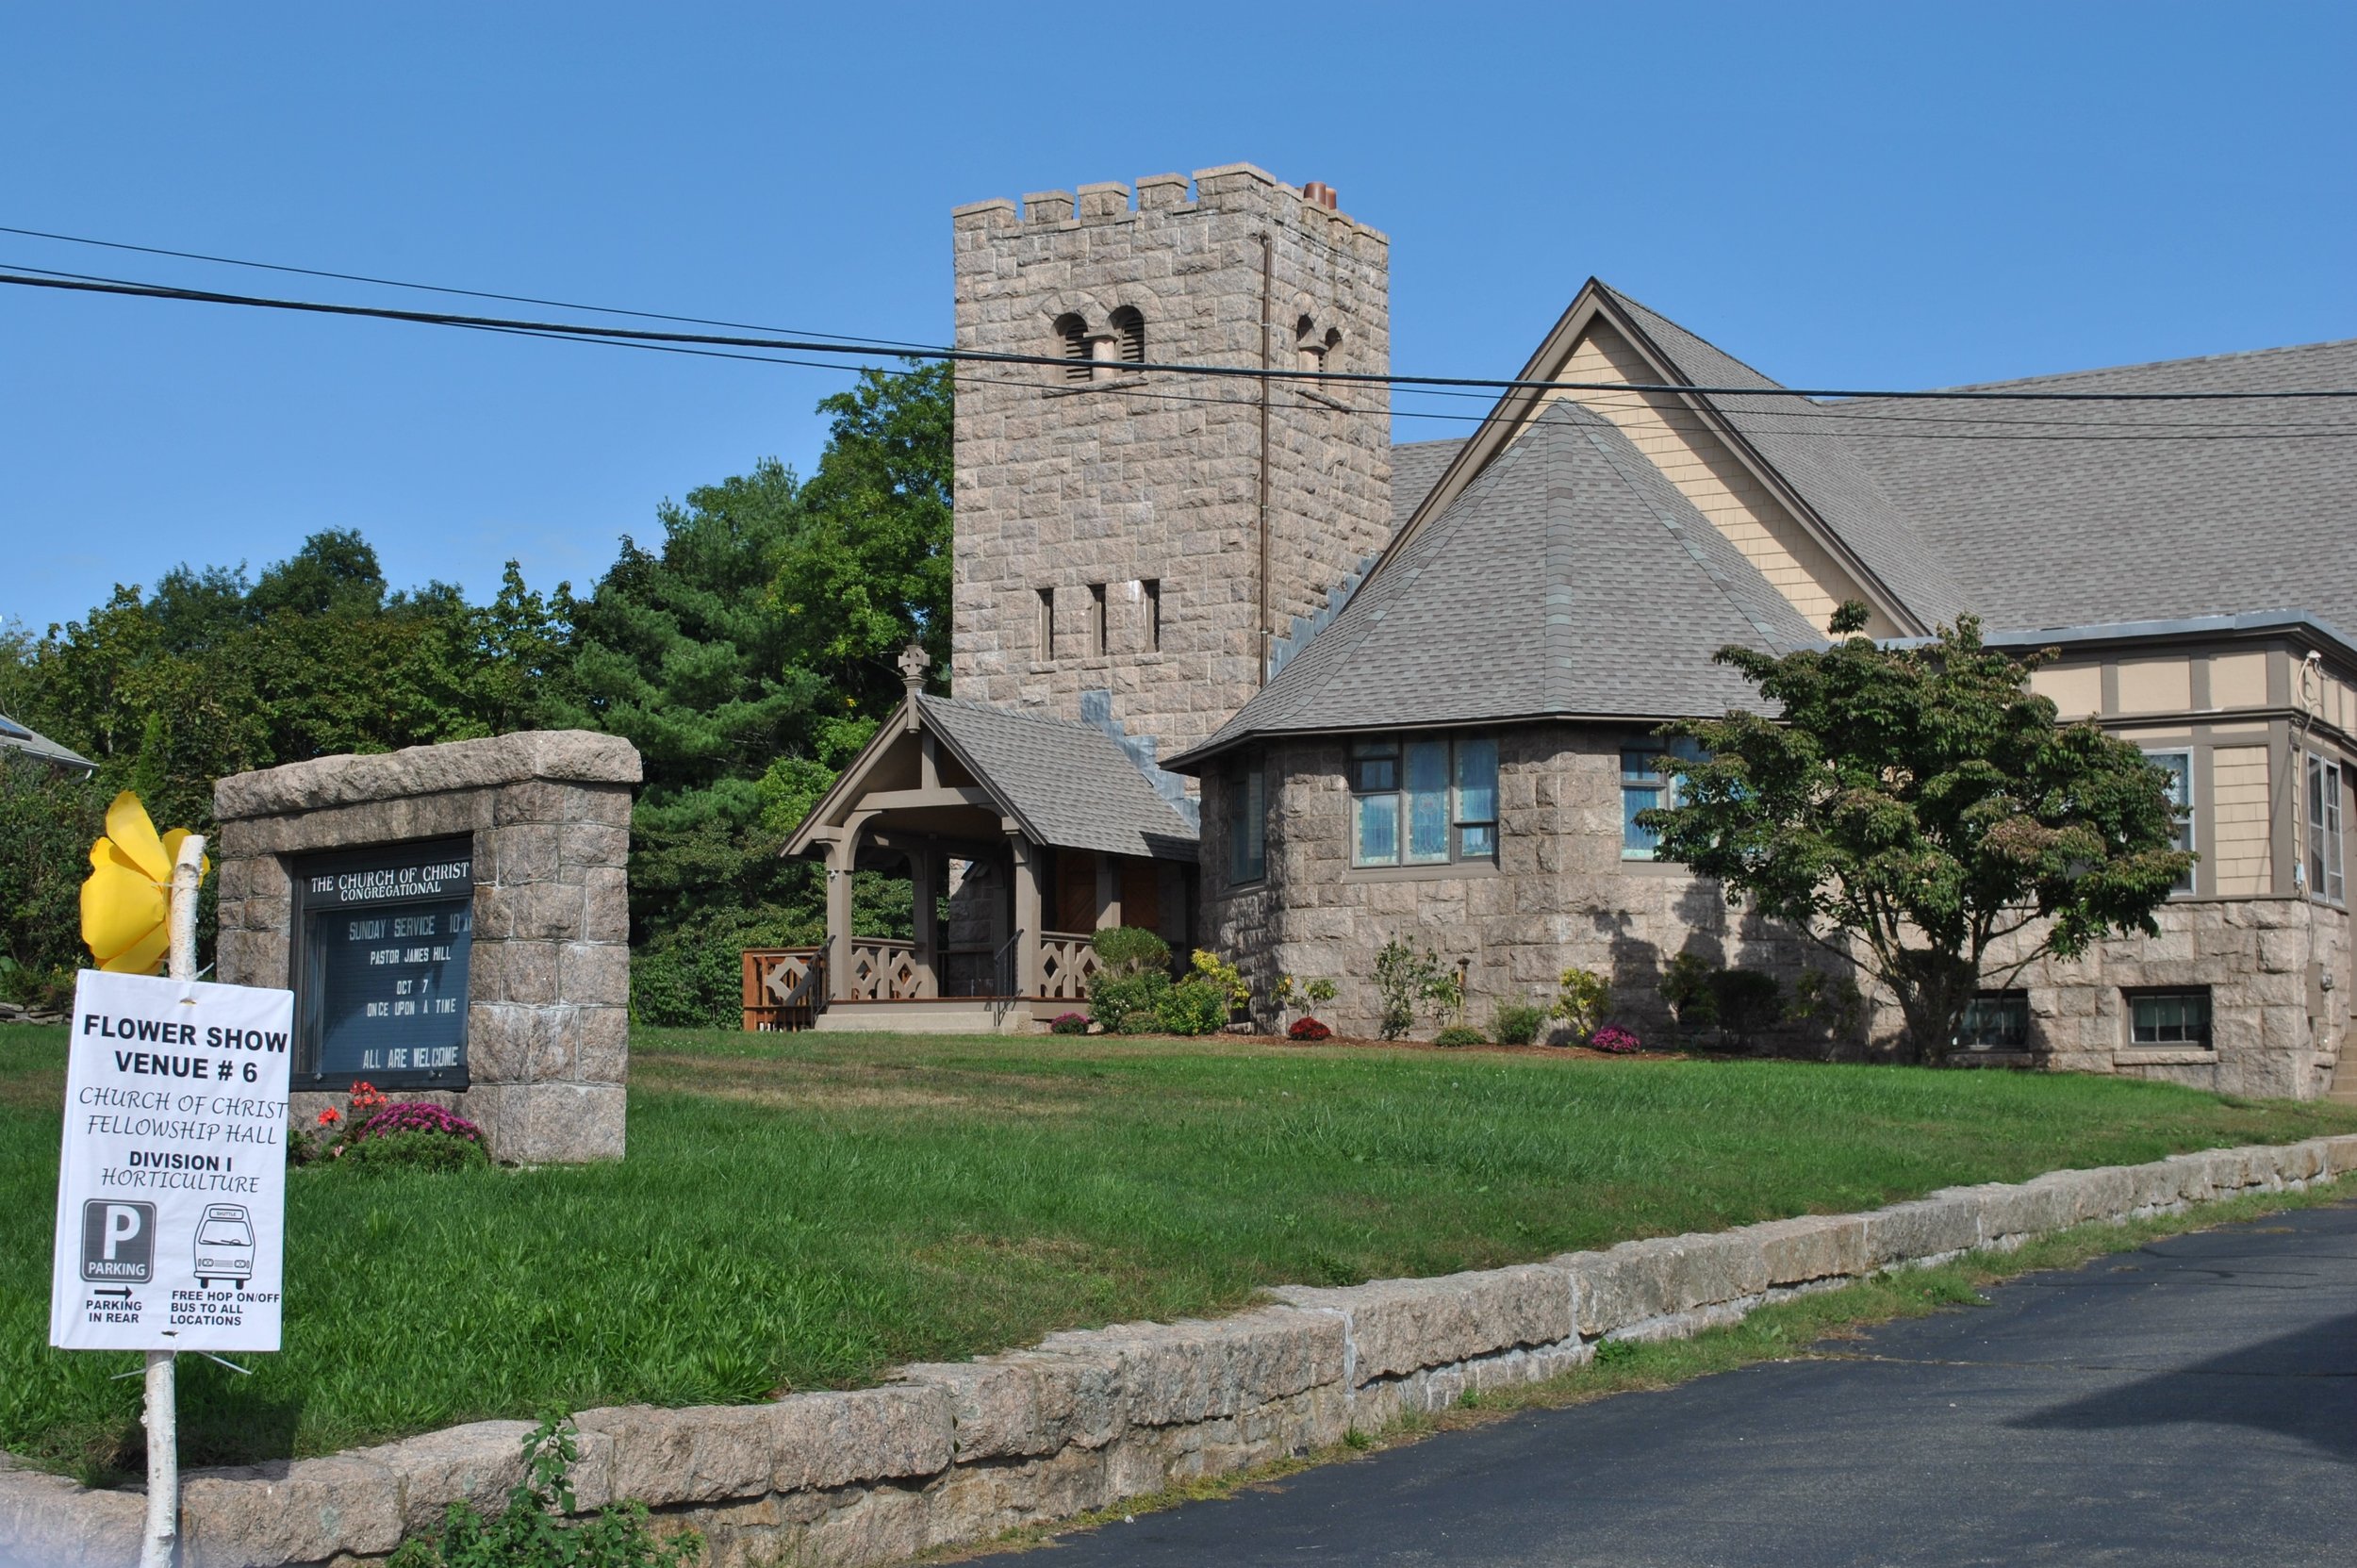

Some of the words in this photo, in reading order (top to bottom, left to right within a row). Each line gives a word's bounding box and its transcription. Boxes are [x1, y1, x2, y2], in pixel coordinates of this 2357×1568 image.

[311, 875, 334, 893] THE
[338, 869, 394, 890] CHURCH
[399, 867, 417, 883] OF
[422, 862, 470, 882] CHRIST
[340, 881, 441, 901] CONGREGATIONAL
[349, 918, 387, 941] SUNDAY
[394, 916, 436, 937] SERVICE
[450, 914, 460, 933] 10
[370, 949, 400, 966] PASTOR
[404, 948, 429, 963] JAMES
[433, 946, 452, 962] HILL
[396, 980, 413, 995] OCT
[422, 979, 429, 994] 7
[367, 1001, 388, 1017] ONCE
[394, 1000, 415, 1015] UPON
[422, 999, 429, 1015] A
[436, 998, 456, 1014] TIME
[84, 1014, 197, 1046] FLOWER
[206, 1027, 288, 1053] SHOW
[115, 1050, 208, 1079] VENUE
[218, 1060, 234, 1081] #
[243, 1062, 257, 1082] 6
[362, 1048, 381, 1069] ALL
[387, 1048, 407, 1068] ARE
[413, 1046, 459, 1068] WELCOME
[79, 1087, 171, 1111] CHURCH
[178, 1096, 207, 1115] OF
[212, 1098, 289, 1119] CHRIST
[88, 1114, 220, 1142] FELLOWSHIP
[226, 1124, 277, 1145] HALL
[129, 1151, 219, 1172] DIVISION
[227, 1157, 232, 1172] I
[101, 1167, 260, 1193] HORTICULTURE
[103, 1205, 140, 1260] P
[89, 1262, 146, 1277] PARKING
[86, 1300, 142, 1312] PARKING
[172, 1291, 203, 1301] FREE
[207, 1292, 233, 1302] HOP
[237, 1293, 280, 1304] ON/OFF
[89, 1312, 102, 1323] IN
[106, 1312, 140, 1324] REAR
[171, 1303, 196, 1312] BUS
[200, 1304, 217, 1313] TO
[221, 1304, 243, 1314] ALL
[170, 1314, 241, 1326] LOCATIONS
